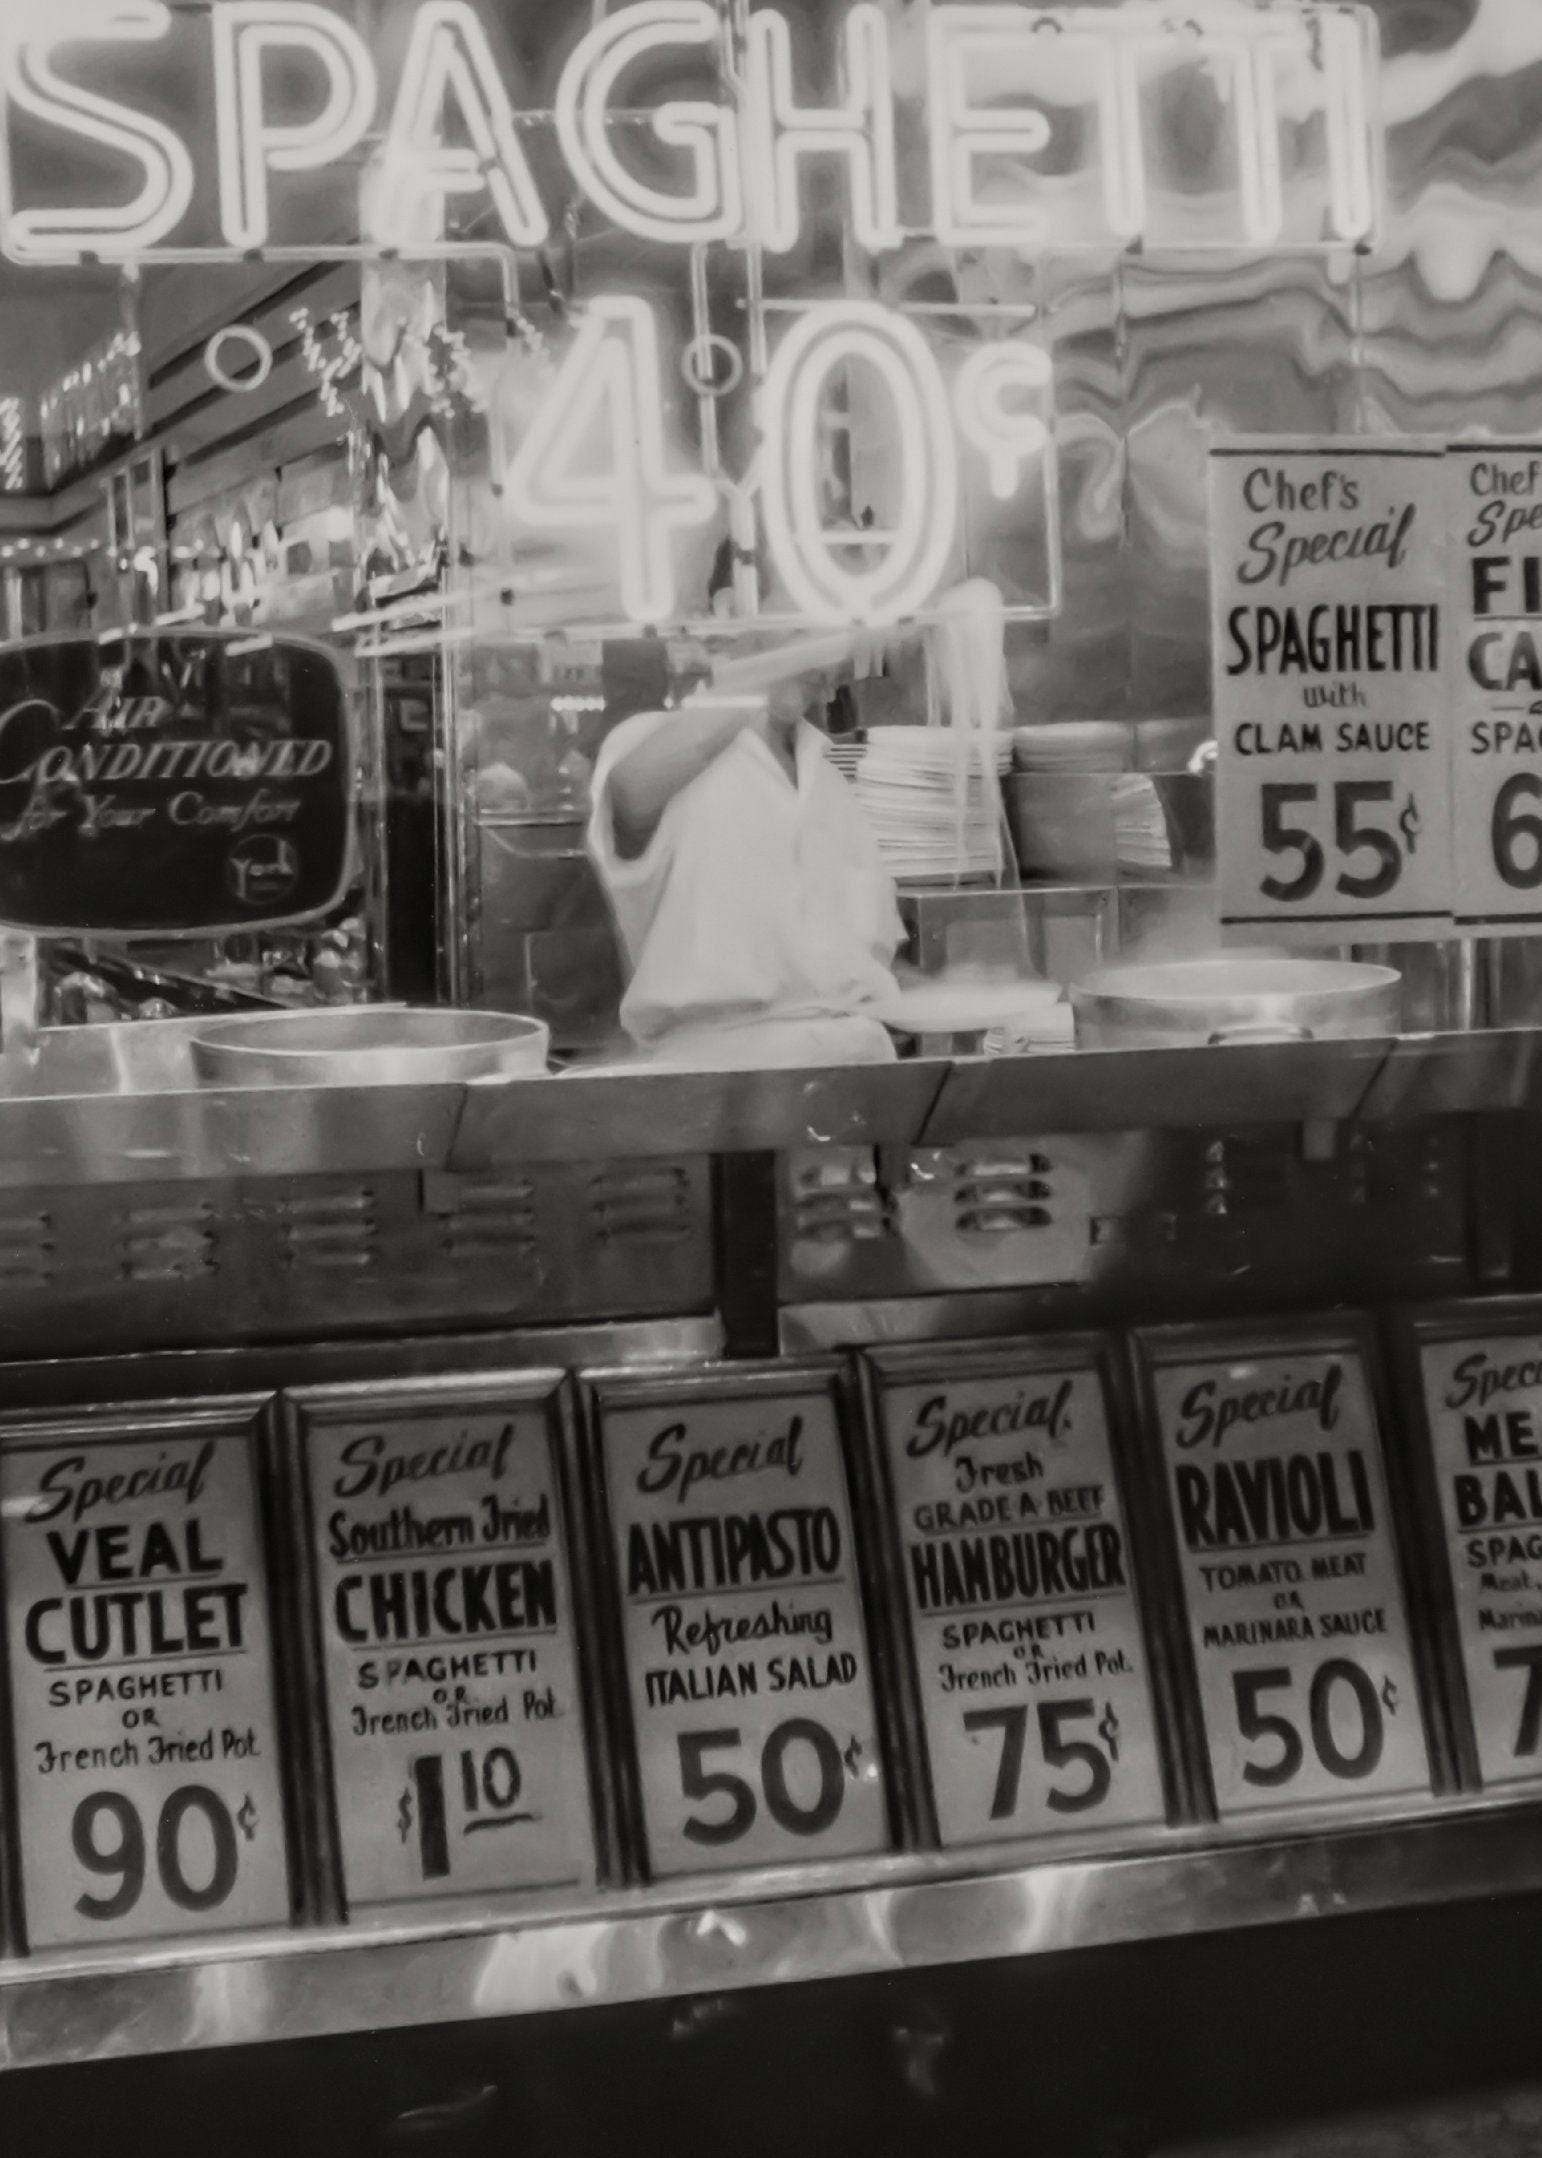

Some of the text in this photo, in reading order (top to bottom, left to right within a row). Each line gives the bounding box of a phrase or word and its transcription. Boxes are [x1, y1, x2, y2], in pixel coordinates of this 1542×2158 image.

[0, 0, 1381, 264] SPAGHETTI
[1243, 468, 1359, 513] Chef's
[1237, 503, 1415, 586] Special
[1227, 604, 1439, 676] SPAGHETTI
[1304, 682, 1366, 708] with
[1235, 720, 1430, 755] CLAM SAUCE
[1259, 779, 1421, 902] 55¢
[1176, 1364, 1341, 1448] Special
[24, 1440, 216, 1525] Special
[333, 1425, 514, 1498] Special
[637, 1415, 803, 1503] Special
[956, 1452, 1043, 1492] Fresh
[329, 1494, 549, 1557] Southern Fried
[915, 1485, 1103, 1532] GRADE A BEEF
[1176, 1450, 1375, 1548] RAVIOLI
[46, 1518, 224, 1587] VEAL
[627, 1506, 840, 1595] ANTIPASTO
[911, 1523, 1126, 1610] HAMBURGER
[1311, 1553, 1366, 1580] MEAT
[25, 1584, 248, 1665] CUTLET
[335, 1559, 557, 1643] CHICKEN
[652, 1601, 833, 1656] Refreshing
[1203, 1607, 1386, 1648] MARINARA SAUCE
[942, 1611, 1095, 1649] SPAGHETTI
[1013, 1643, 1043, 1659] OR
[49, 1669, 223, 1707] SPAGHETTI
[358, 1650, 536, 1689] SPAGHETTI
[433, 1686, 467, 1704] OR
[645, 1652, 857, 1707] ITALIAN SALAD
[939, 1663, 1016, 1692] French
[1026, 1654, 1087, 1685] Fried
[122, 1708, 159, 1728] OR
[352, 1706, 437, 1736] French
[446, 1695, 508, 1728] Fried
[35, 1739, 138, 1774] French
[148, 1729, 213, 1764] Fried
[964, 1699, 1119, 1820] 75¢
[71, 1784, 259, 1922] 90¢
